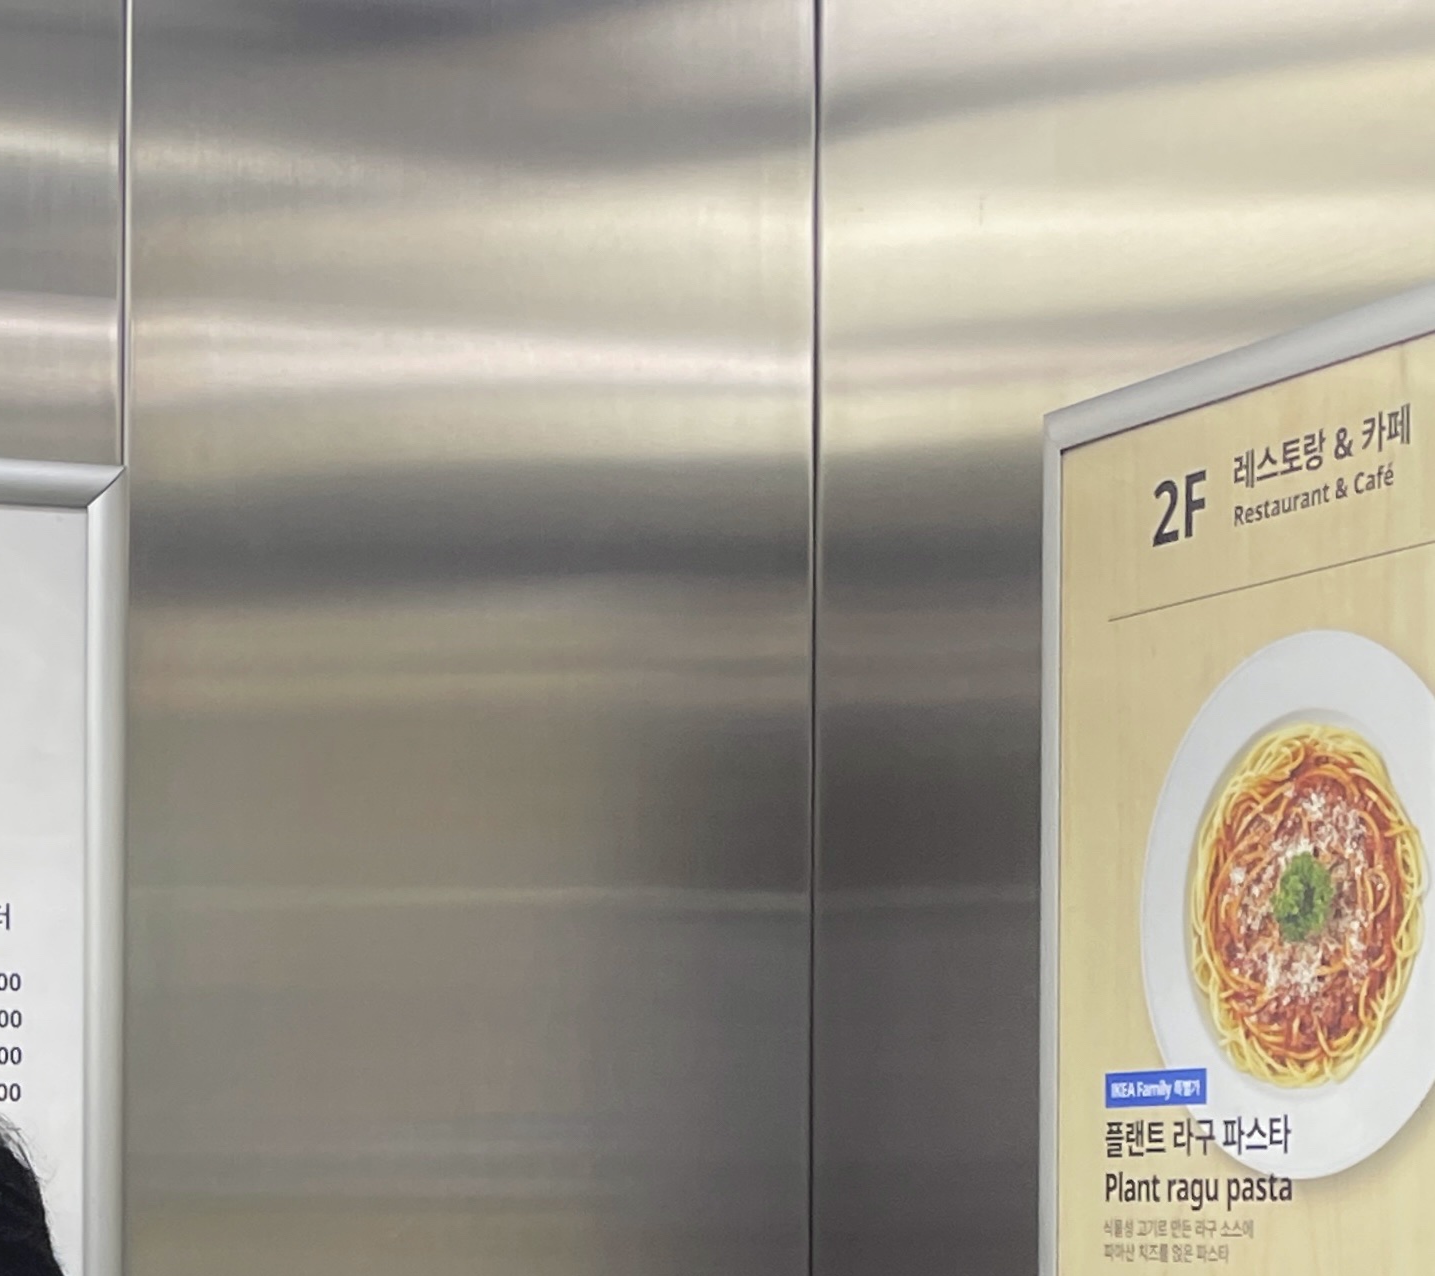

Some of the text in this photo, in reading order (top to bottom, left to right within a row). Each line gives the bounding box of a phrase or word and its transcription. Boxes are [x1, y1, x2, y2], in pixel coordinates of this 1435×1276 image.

[1233, 402, 1411, 489] 레스토랑 & 카페
[1152, 469, 1207, 548] 2F
[1233, 461, 1395, 528] Restaurant & Café
[1137, 1079, 1172, 1101] Family
[1105, 1113, 1292, 1158] 플랜트 라구 파스타
[1105, 1171, 1294, 1212] Plant ragu pasta
